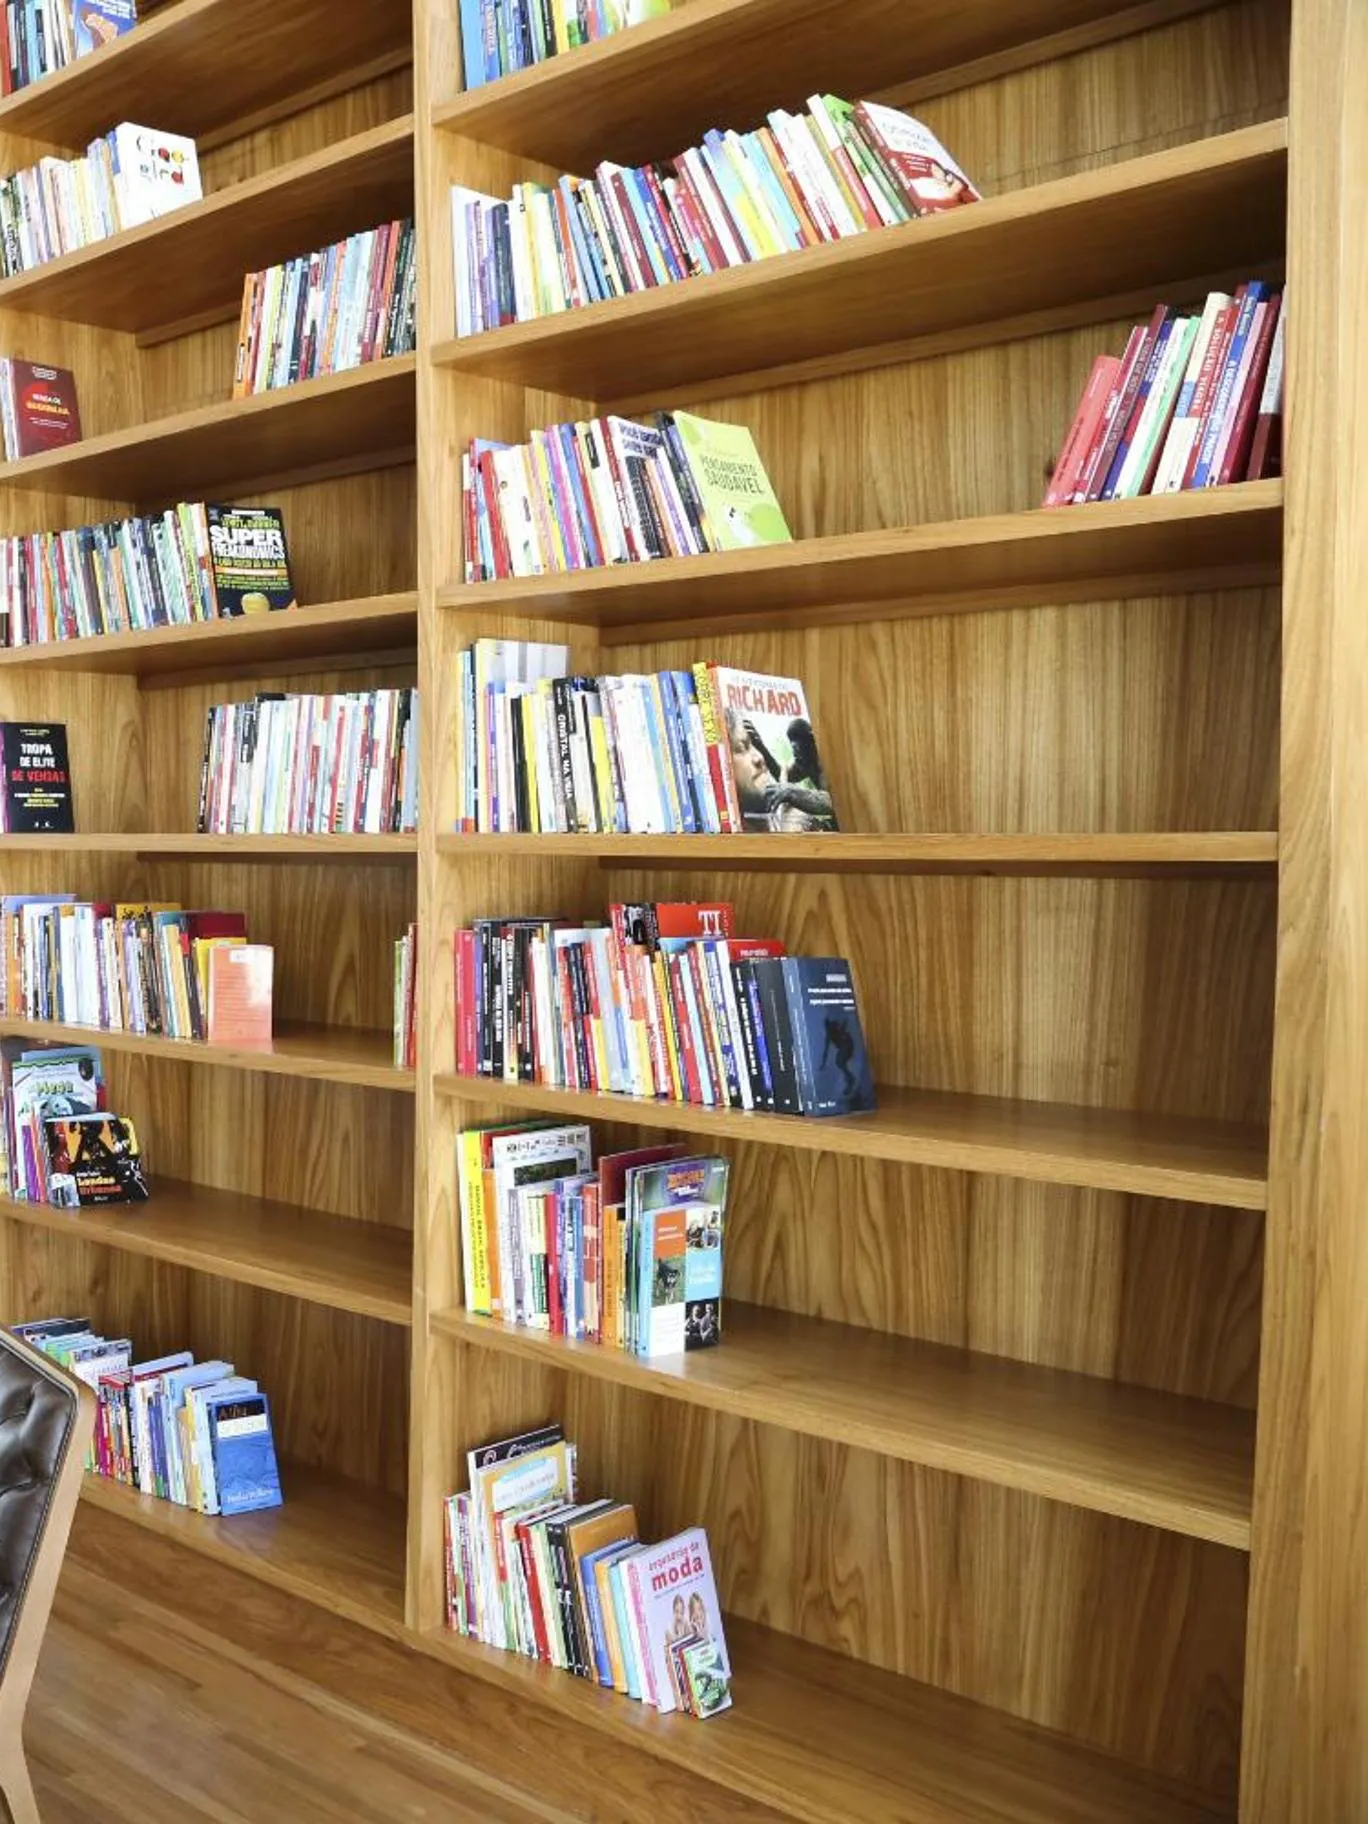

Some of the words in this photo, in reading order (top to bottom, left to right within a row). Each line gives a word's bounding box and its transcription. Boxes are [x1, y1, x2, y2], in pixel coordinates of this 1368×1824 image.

[210, 524, 284, 547] SUPER
[727, 683, 802, 716] RICHARD
[20, 743, 53, 755] TROPA
[19, 756, 31, 767] DE
[32, 757, 55, 768] ELITE
[652, 1556, 703, 1592] moda
